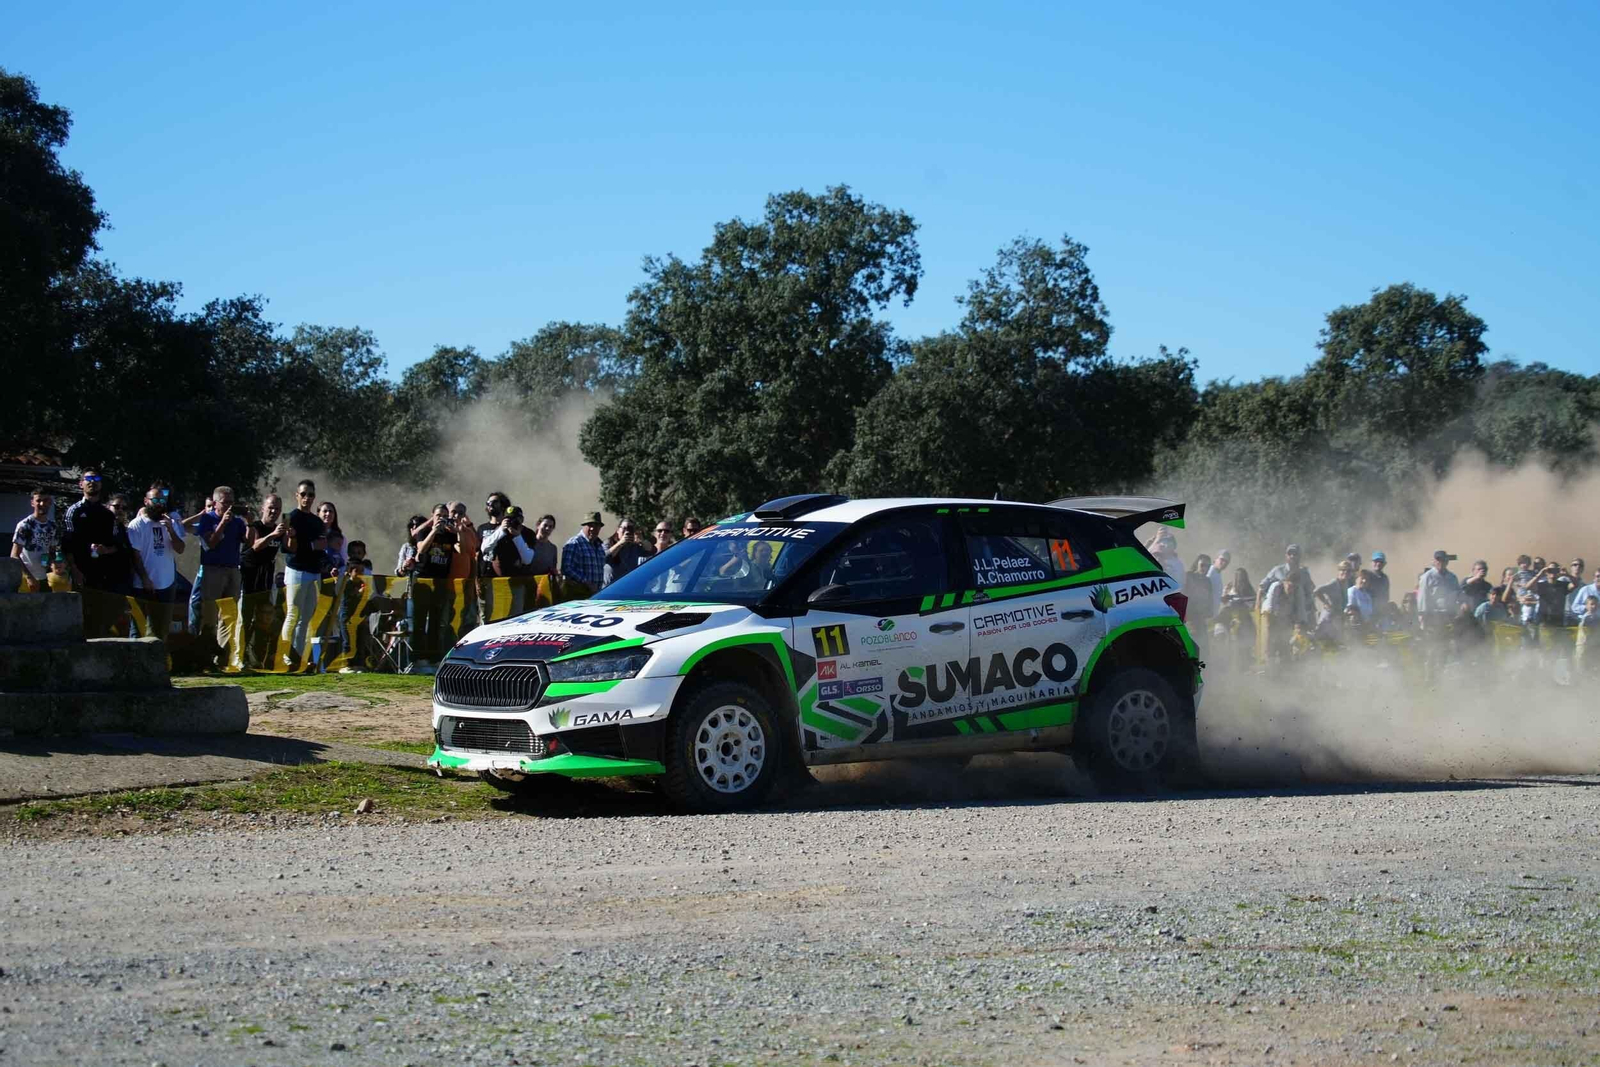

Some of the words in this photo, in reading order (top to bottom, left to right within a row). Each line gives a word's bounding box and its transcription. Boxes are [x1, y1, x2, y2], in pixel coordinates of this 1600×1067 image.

[699, 527, 816, 539] CARMOTIVE
[973, 556, 1031, 571] J.L.Pelaez
[1052, 538, 1077, 571] 11
[977, 570, 1045, 585] A.Chamorro
[1114, 578, 1172, 605] GAMA
[973, 603, 1056, 629] CARMOTIVE
[815, 626, 845, 656] 11
[897, 642, 1078, 708] SUMACO
[911, 702, 974, 720] ANDAMIOS
[991, 686, 1071, 707] MAQUINARIA
[573, 709, 634, 726] GAMA
